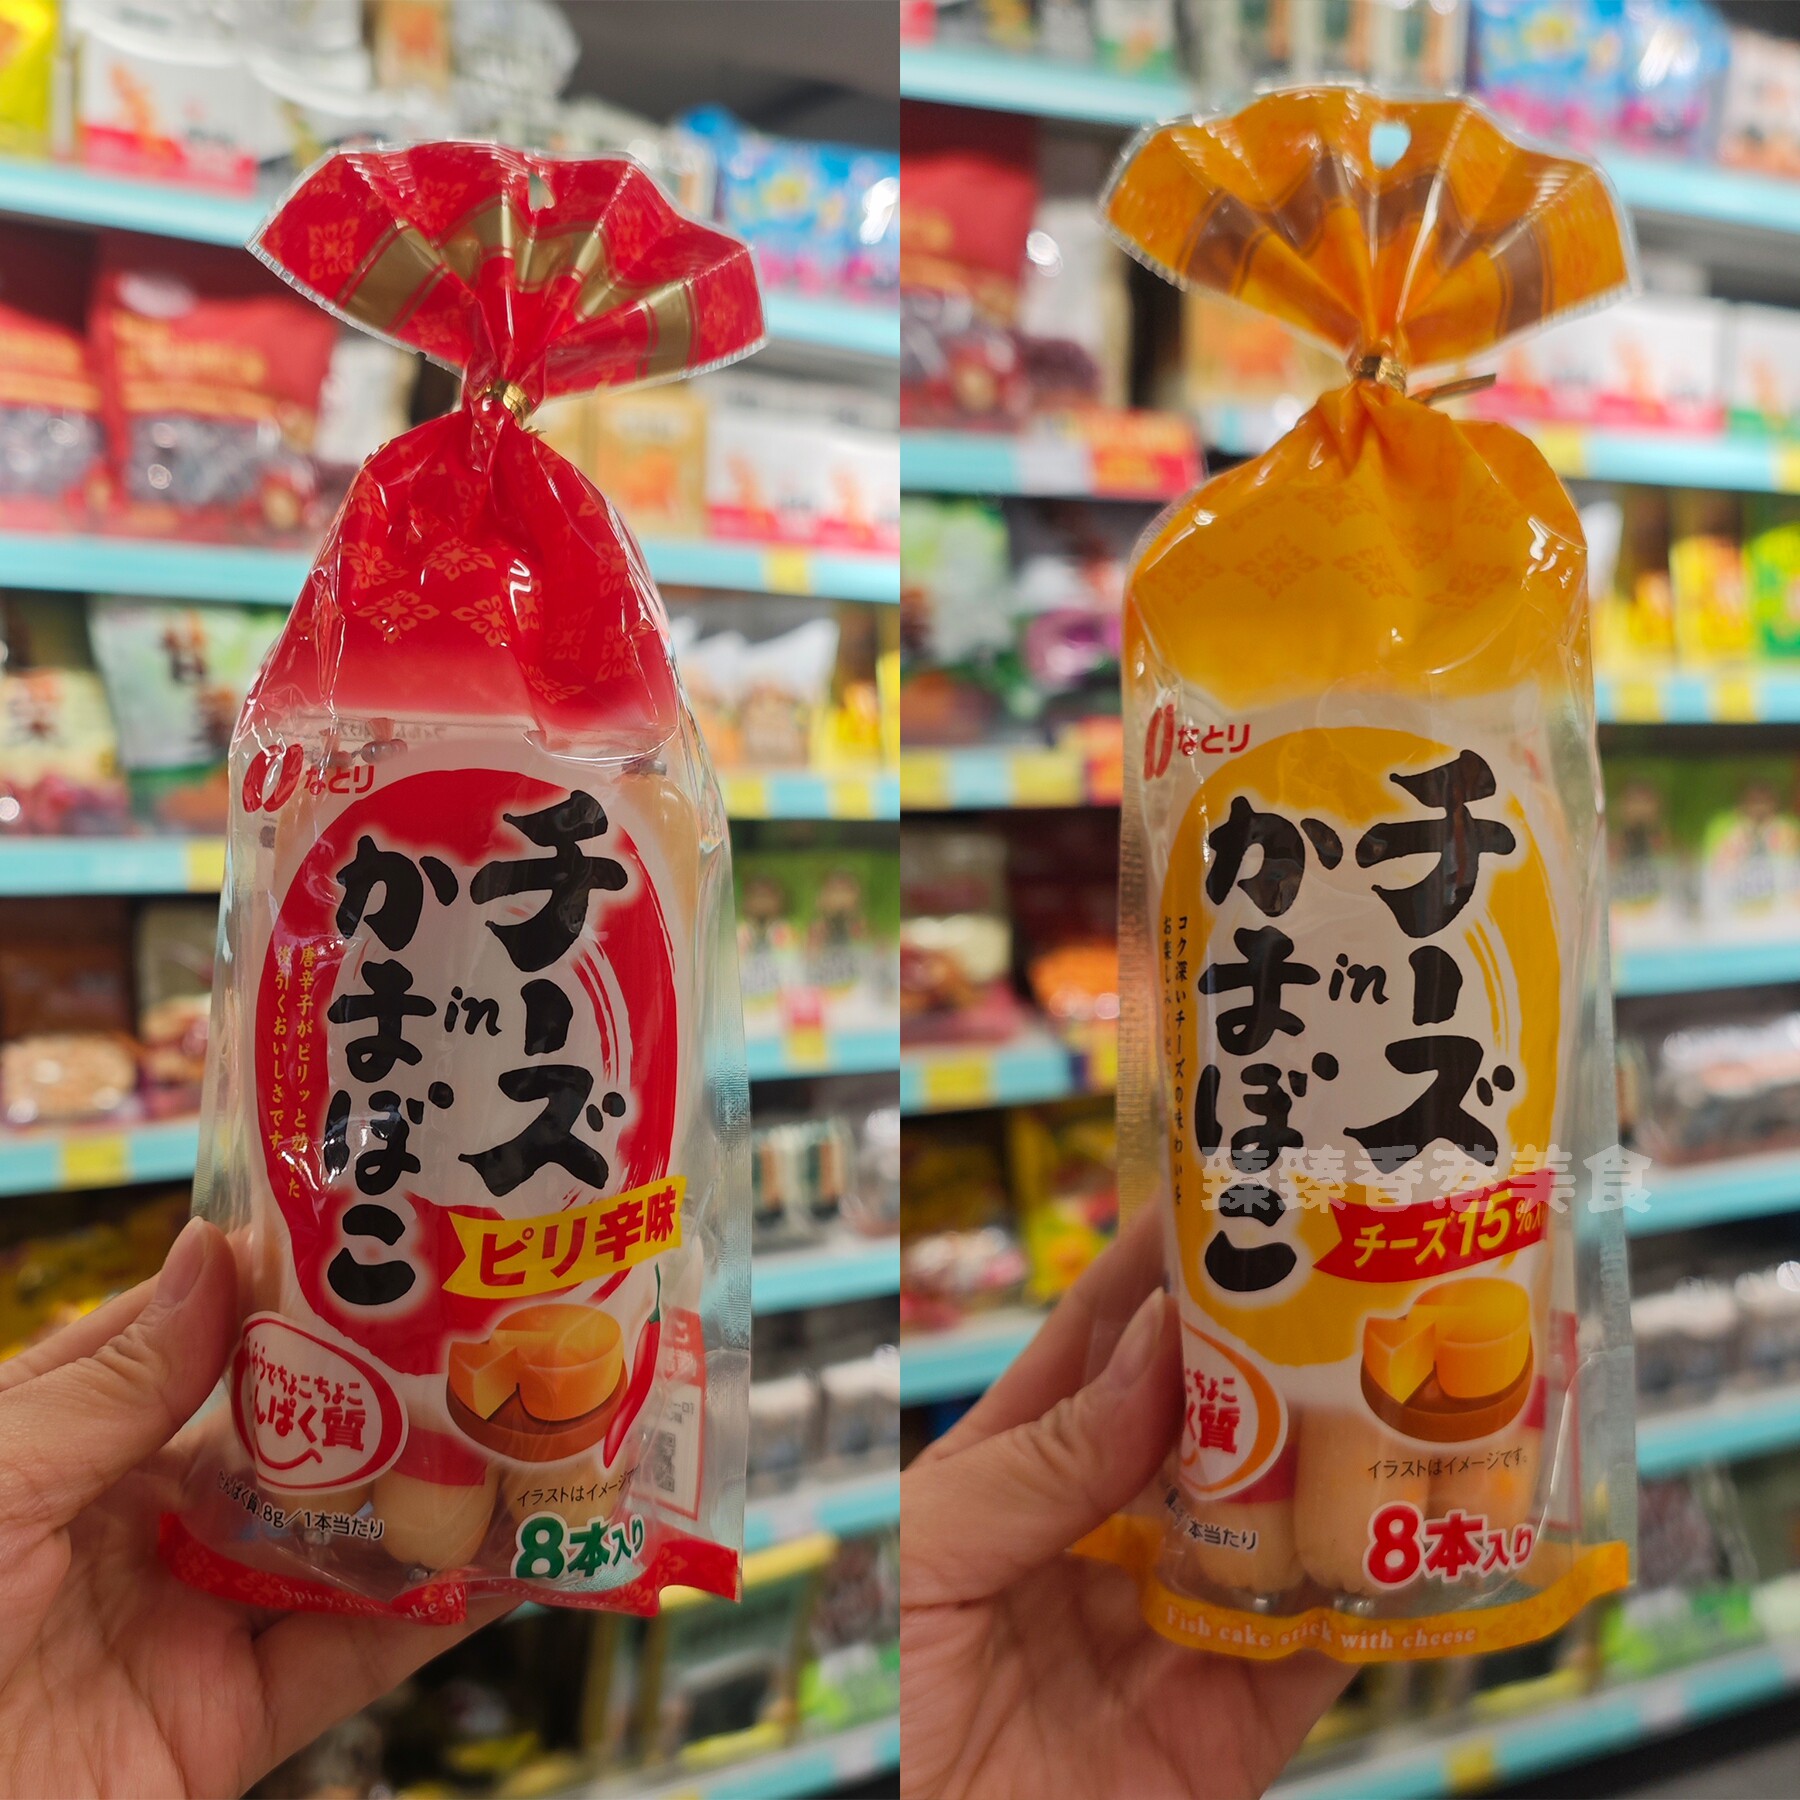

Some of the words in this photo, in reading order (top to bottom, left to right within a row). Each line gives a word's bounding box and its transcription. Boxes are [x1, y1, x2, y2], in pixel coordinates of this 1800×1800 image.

[1178, 722, 1250, 756] なとり
[304, 765, 375, 796] なとり
[458, 790, 629, 1197] チーズ
[1329, 954, 1389, 1004] in
[1343, 749, 1516, 1174] チーズ
[443, 986, 503, 1037] in
[324, 835, 459, 1305] かまぼこ
[1195, 796, 1343, 1292] かまぼこ
[480, 1185, 677, 1287] ピリ辛味
[252, 1384, 366, 1451] んぱく質
[1367, 1447, 1528, 1480] イラストはイメージです。
[516, 1516, 644, 1578] 8本入り
[1367, 1505, 1533, 1584] 8本入り
[1167, 1605, 1211, 1637] Fish
[1218, 1624, 1272, 1648] cake
[1279, 1619, 1333, 1646] stick
[1340, 1629, 1394, 1650] with
[1402, 1625, 1477, 1649] cheese
